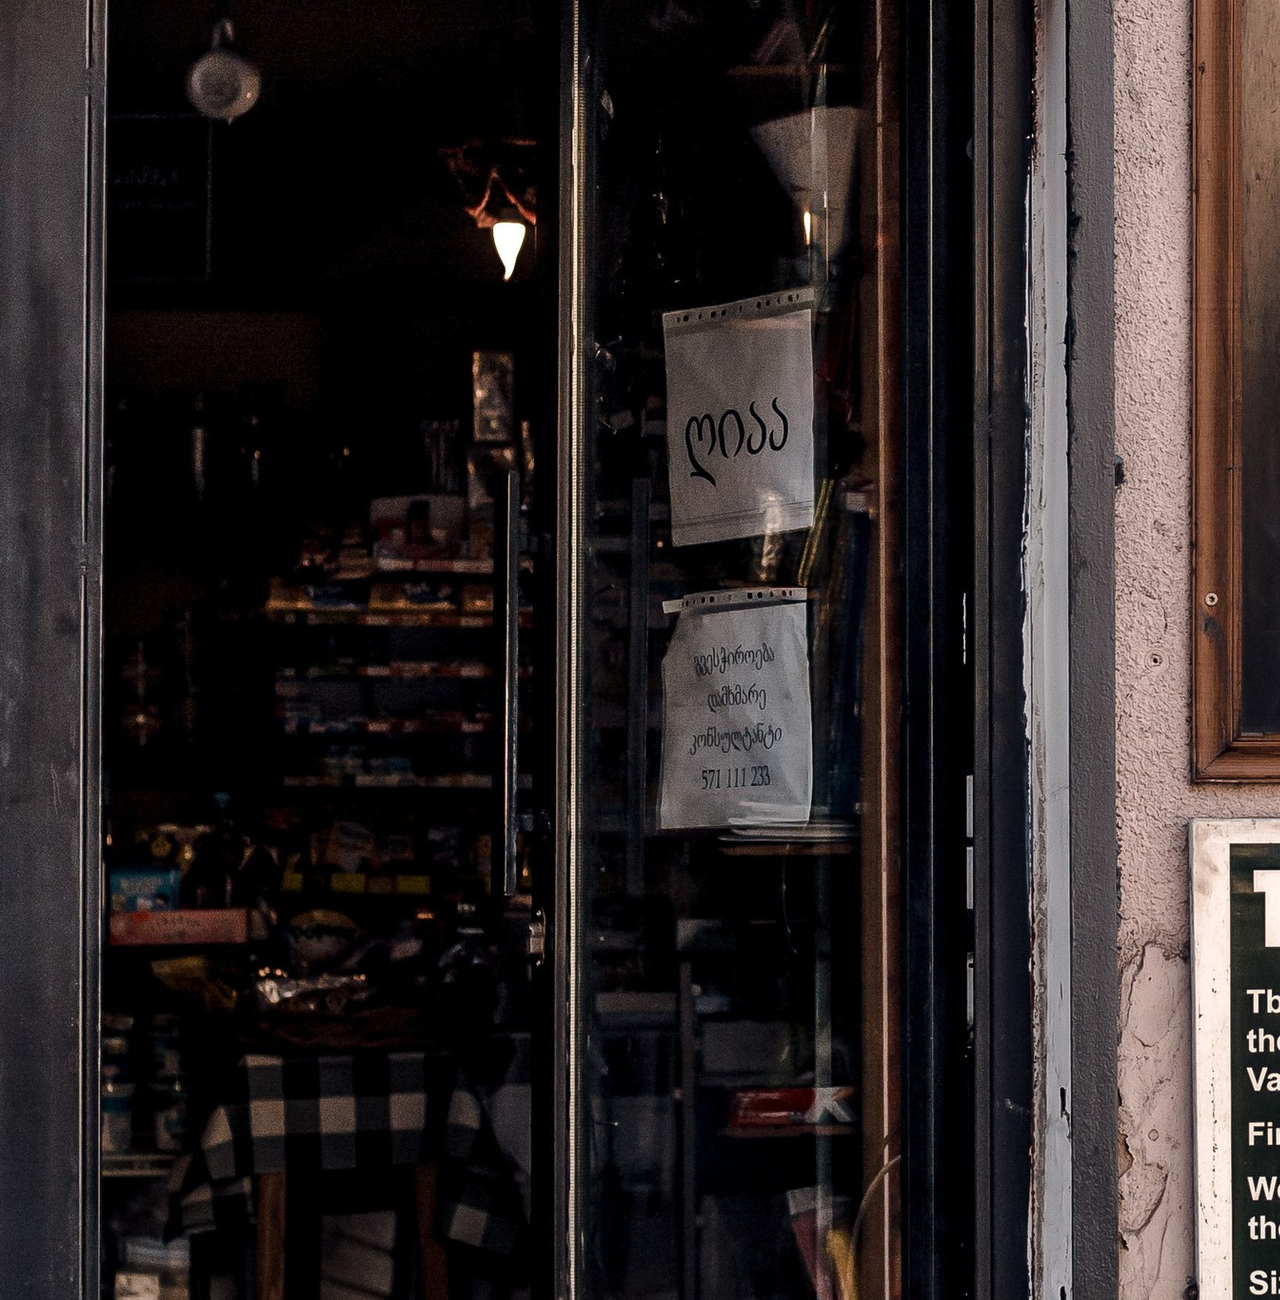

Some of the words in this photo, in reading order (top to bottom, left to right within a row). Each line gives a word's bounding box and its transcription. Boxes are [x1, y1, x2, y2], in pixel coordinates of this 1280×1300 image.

[685, 397, 789, 487] ღიაა
[708, 683, 767, 712] დამხმარე
[701, 768, 721, 790] 571
[727, 767, 746, 789] 111
[751, 765, 771, 787] 233
